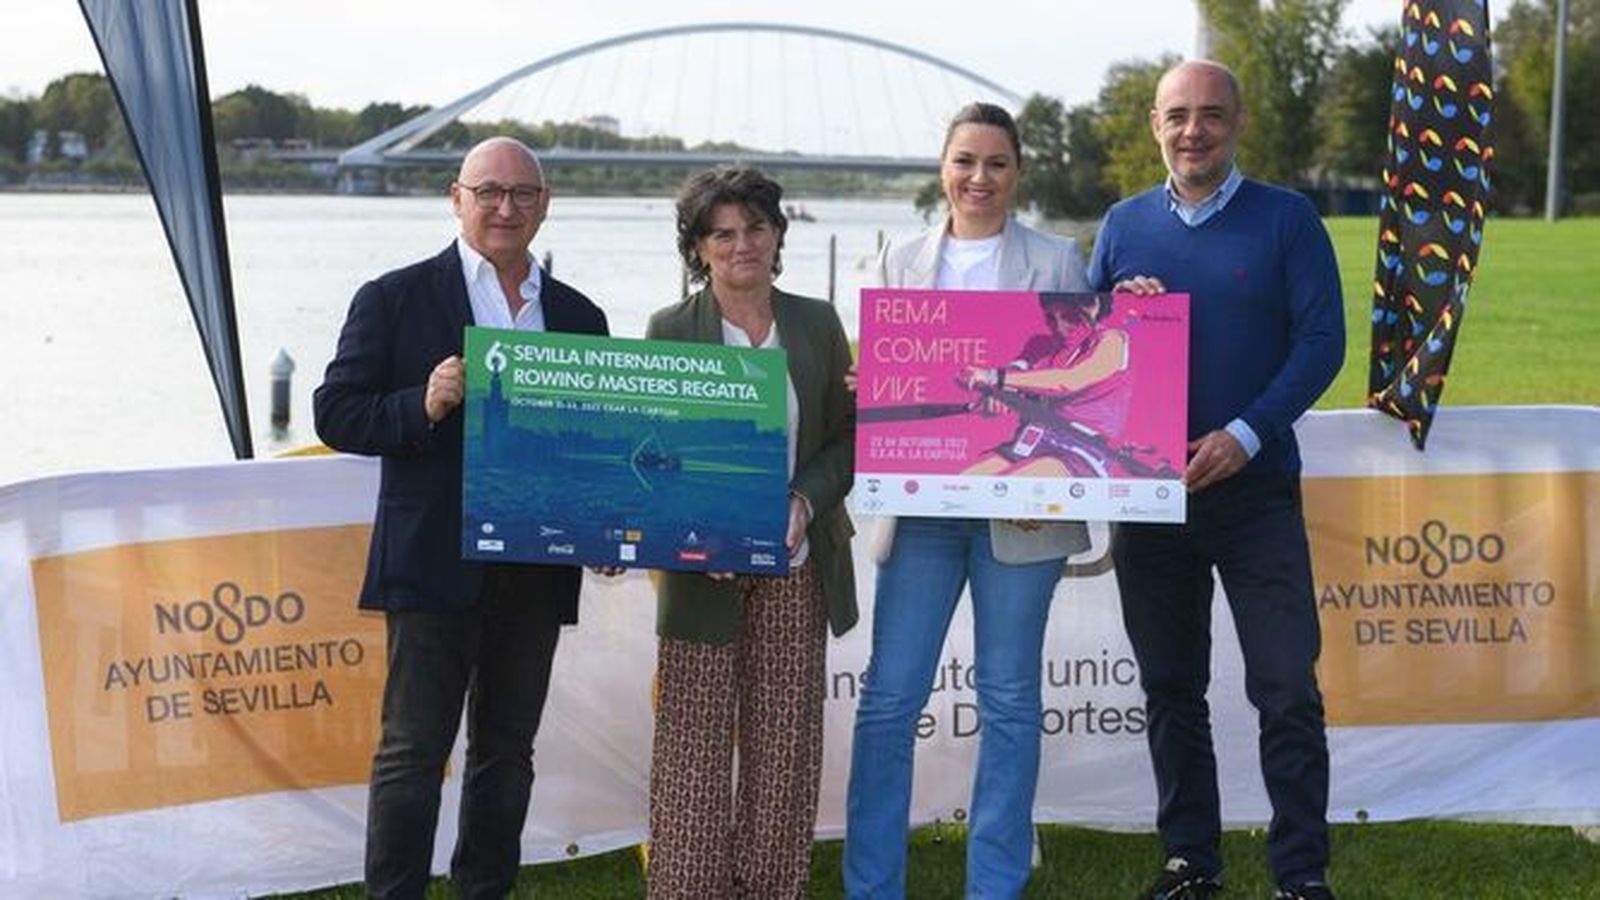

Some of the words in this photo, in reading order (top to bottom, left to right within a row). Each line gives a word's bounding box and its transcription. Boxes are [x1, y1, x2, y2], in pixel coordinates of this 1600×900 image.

[875, 300, 947, 324] REMA
[513, 344, 581, 365] SEVILLA
[585, 351, 725, 375] INTERNATIONAL
[873, 338, 987, 364] COMPITE
[513, 368, 595, 389] ROWING
[598, 375, 678, 396] MASTERS
[681, 381, 759, 401] REGATTA
[871, 376, 927, 401] VIVE
[1318, 581, 1556, 610] AYUNTAMIENTO
[1355, 619, 1395, 645] DE
[1405, 617, 1528, 644] SEVILLA
[104, 638, 365, 690] AYUNTAMIENTO
[146, 692, 192, 722] DE
[202, 680, 333, 714] SEVILLA
